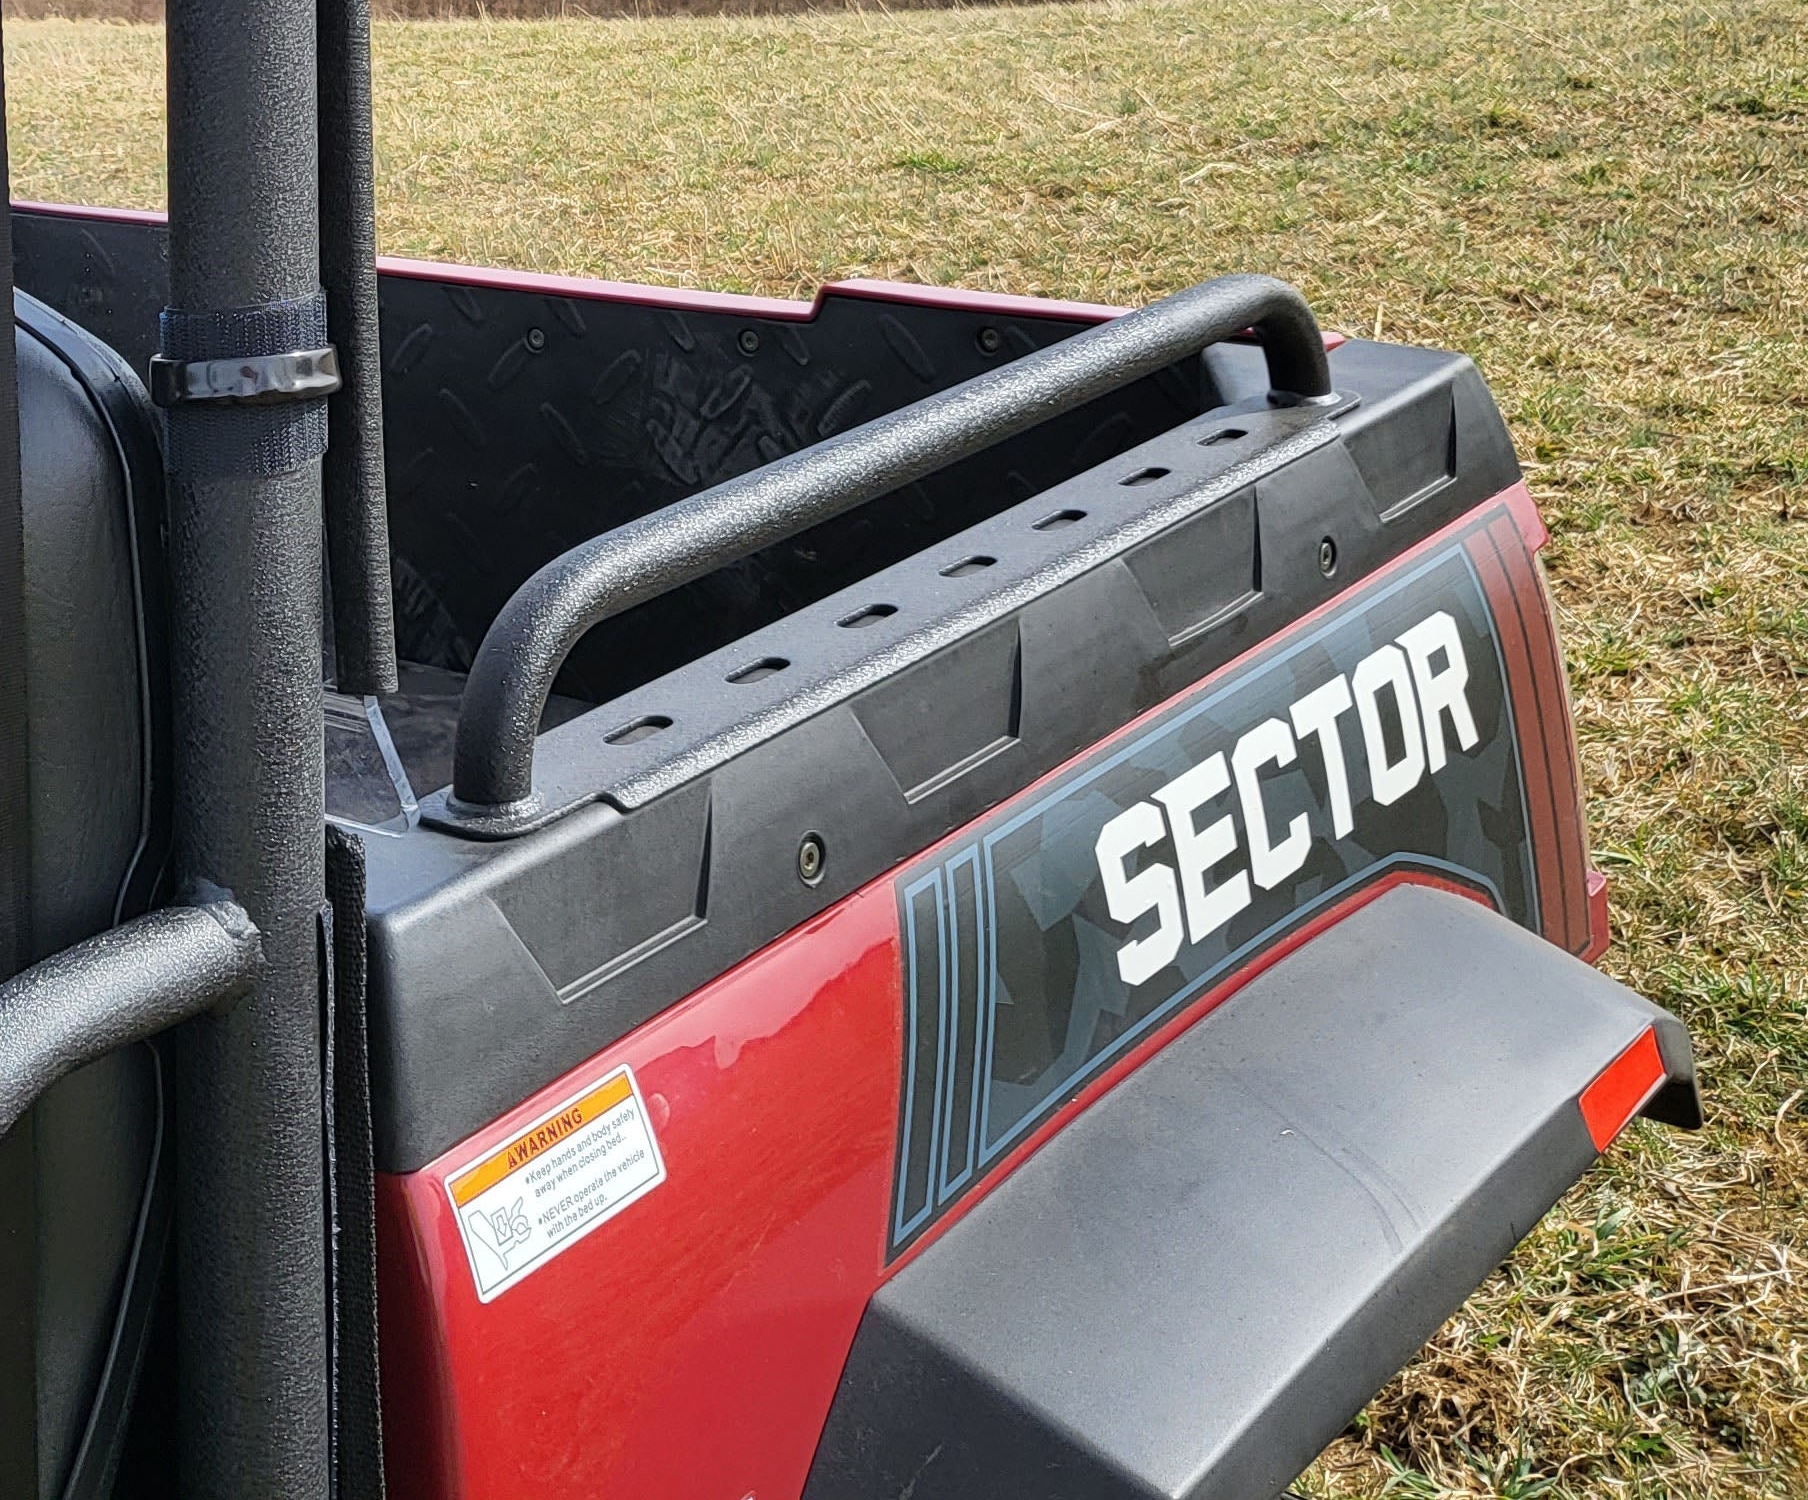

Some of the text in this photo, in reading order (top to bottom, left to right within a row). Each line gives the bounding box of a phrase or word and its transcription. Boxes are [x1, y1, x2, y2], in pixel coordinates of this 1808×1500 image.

[1094, 609, 1479, 986] SECTOR
[514, 1107, 583, 1162] WARNING
[551, 1146, 576, 1167] hands
[577, 1136, 592, 1153] and
[592, 1124, 611, 1143] body
[612, 1108, 635, 1129] safely
[535, 1178, 556, 1198] away
[556, 1163, 579, 1183] when
[578, 1144, 607, 1169] closing
[542, 1150, 645, 1224] NEVER operate the vehicle
[547, 1194, 608, 1239] with the bed up.
